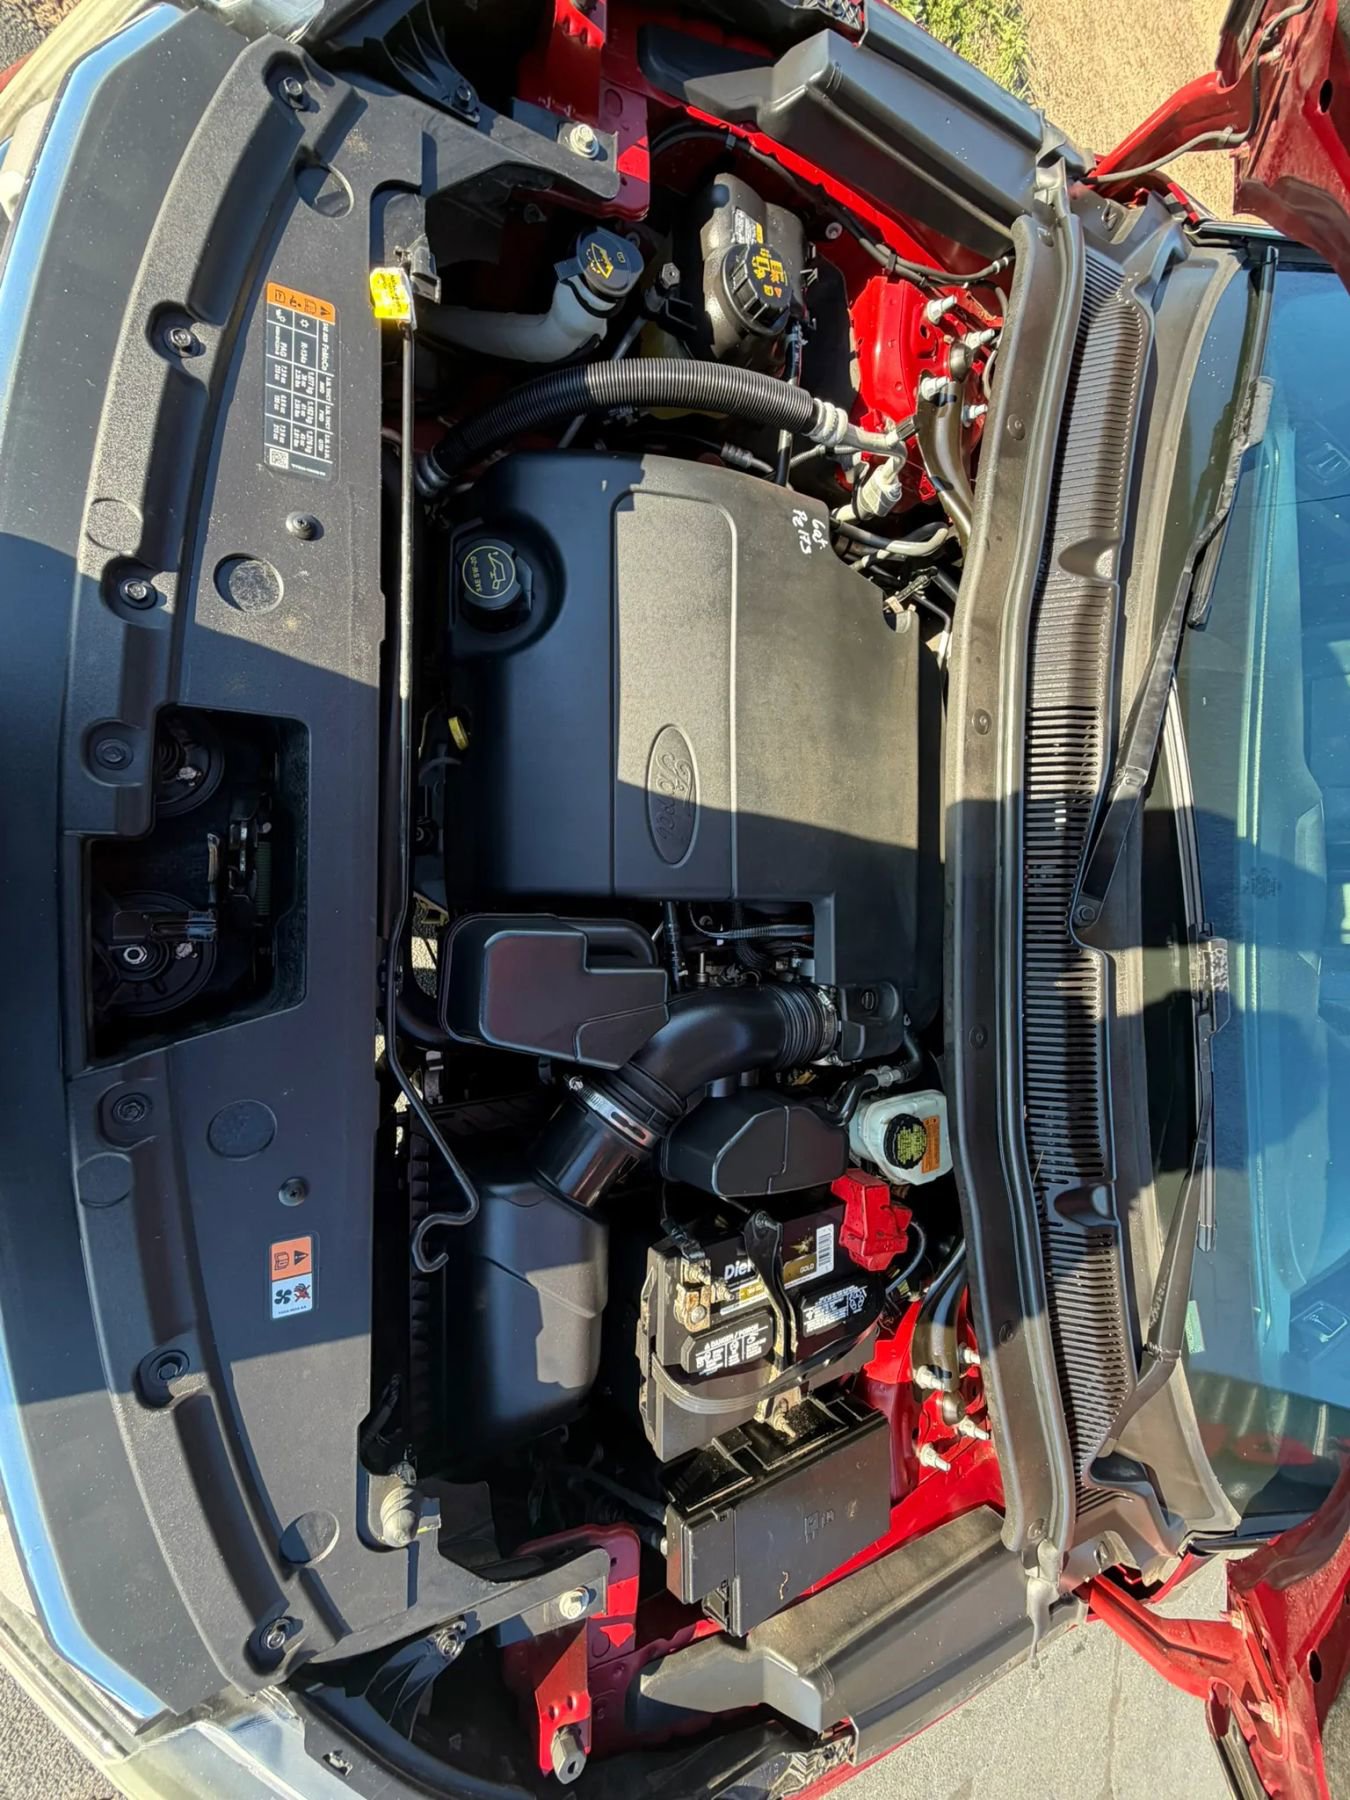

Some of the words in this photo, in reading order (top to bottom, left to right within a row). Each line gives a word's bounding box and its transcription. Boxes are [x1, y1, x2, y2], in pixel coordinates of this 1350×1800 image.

[306, 386, 314, 395] kg
[306, 415, 313, 424] kg
[305, 445, 313, 454] kg
[655, 752, 695, 839] Ford
[799, 1263, 815, 1274] GOLD
